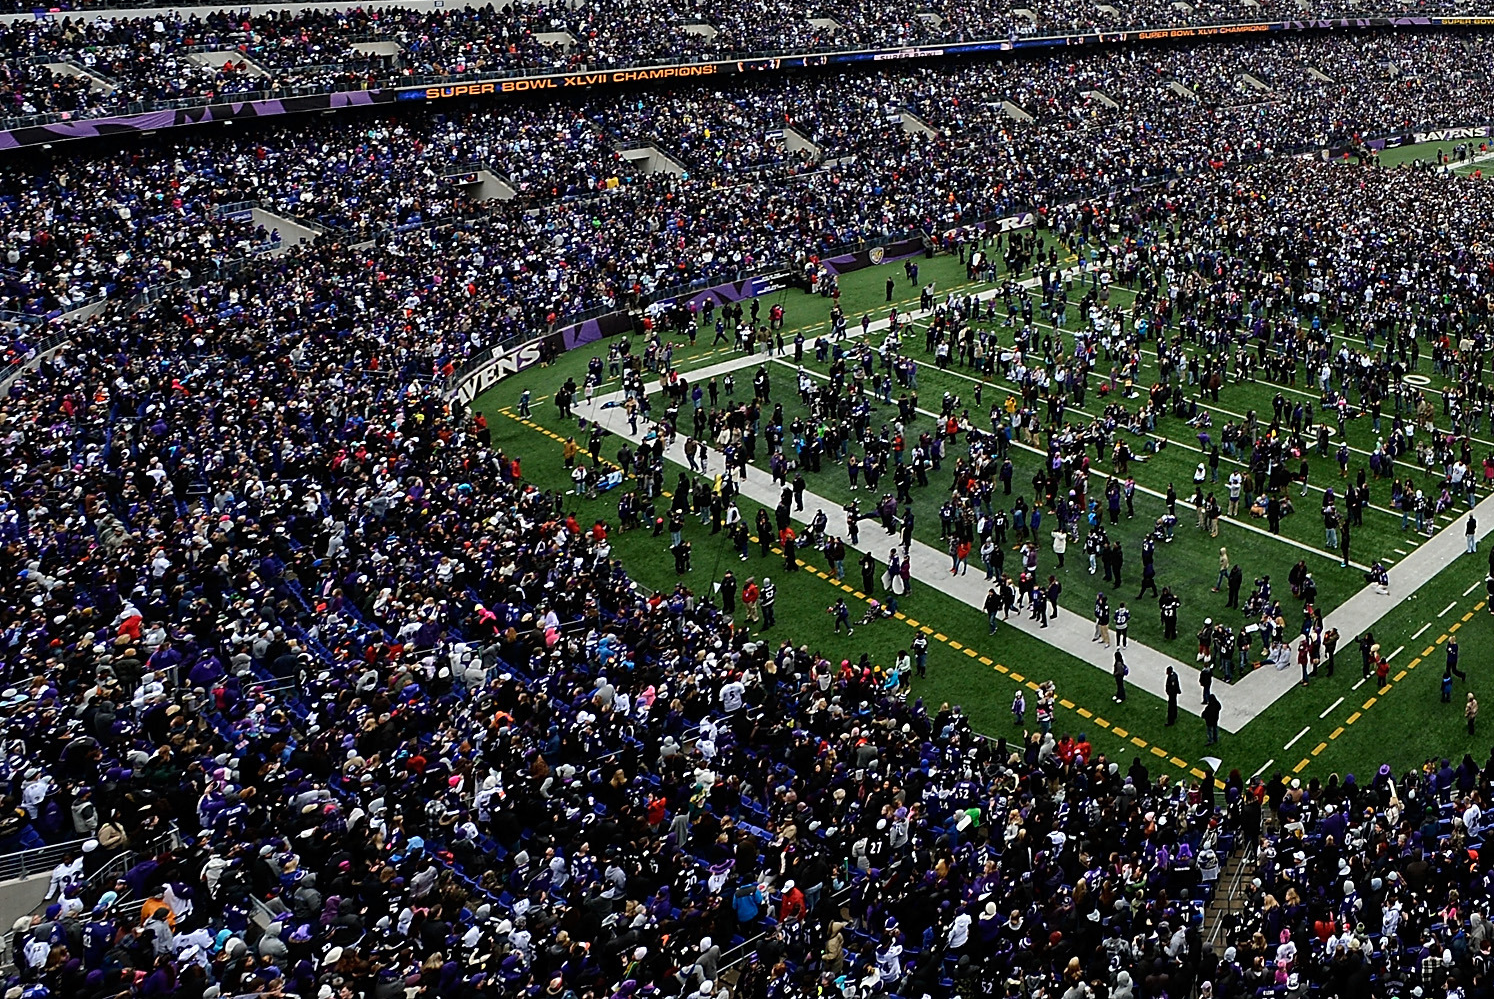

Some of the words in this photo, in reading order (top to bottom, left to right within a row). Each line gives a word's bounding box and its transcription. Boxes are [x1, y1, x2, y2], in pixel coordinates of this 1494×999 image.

[1139, 31, 1169, 40] SUPER
[1170, 30, 1196, 38] BOWL
[1198, 28, 1218, 36] XLVII
[1219, 25, 1269, 34] CHAMPIONS!
[425, 83, 496, 99] SUPER
[501, 78, 558, 92] BOWL
[563, 74, 607, 87] XLVII
[612, 64, 717, 83] CHAMPIONS!
[1413, 127, 1487, 143] RAVENS
[1117, 615, 1126, 624] 20
[958, 788, 969, 799] 52
[1299, 811, 1312, 823] 27
[870, 840, 883, 854] 27
[981, 981, 993, 994] 52
